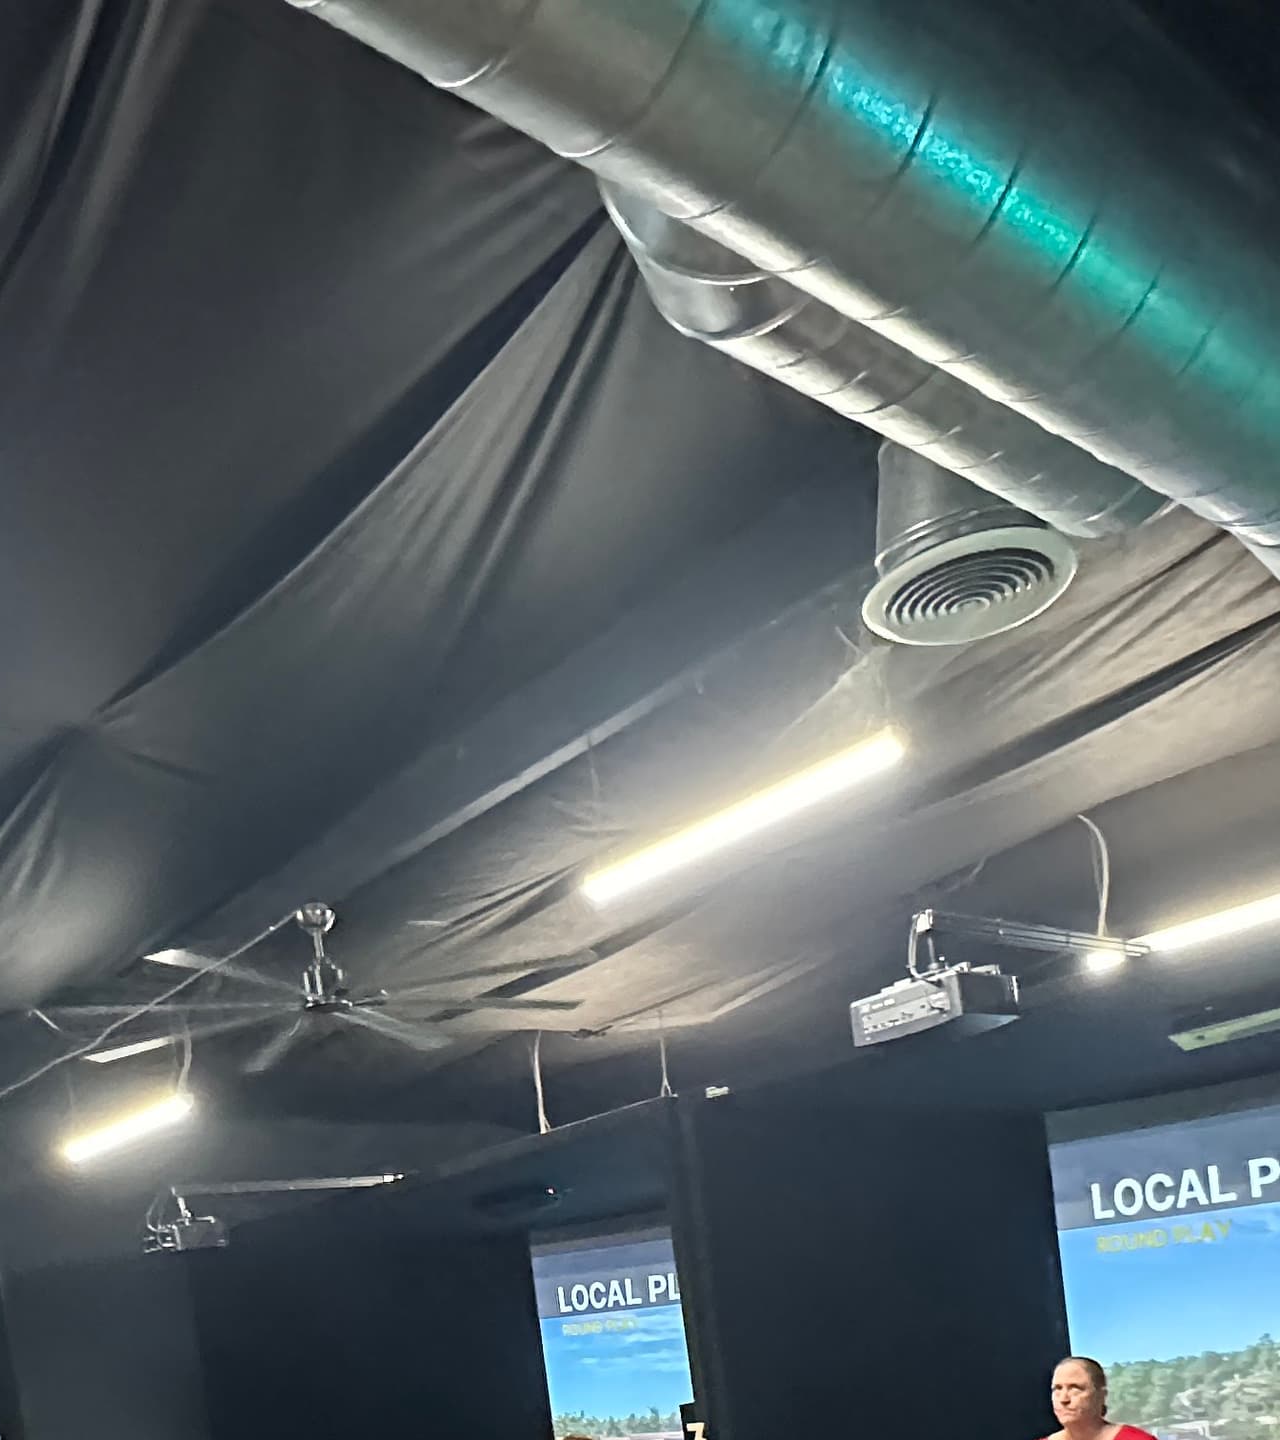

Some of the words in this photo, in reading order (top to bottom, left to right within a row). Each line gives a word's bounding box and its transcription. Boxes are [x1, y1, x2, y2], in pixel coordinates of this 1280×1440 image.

[1090, 1165, 1238, 1220] LOCAL
[1096, 1228, 1168, 1252] ROUND
[1174, 1219, 1233, 1244] PLAY
[557, 1278, 642, 1313] LOCAL
